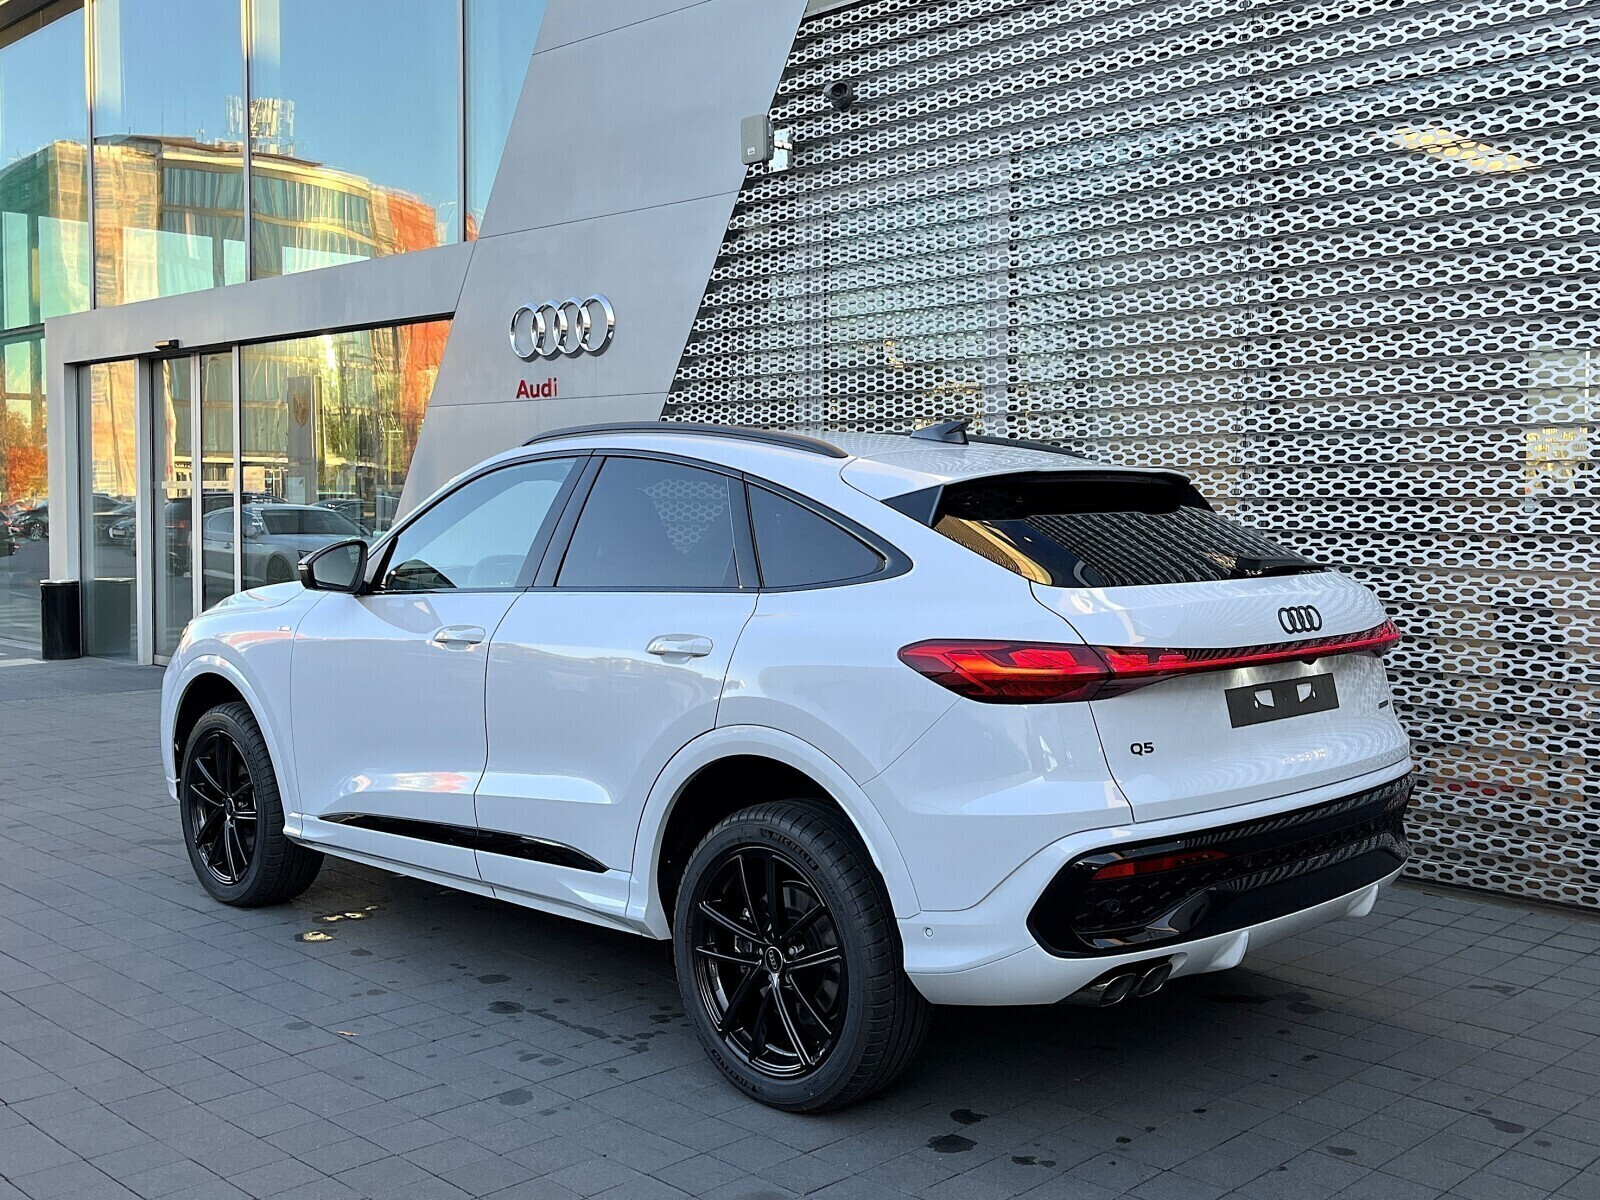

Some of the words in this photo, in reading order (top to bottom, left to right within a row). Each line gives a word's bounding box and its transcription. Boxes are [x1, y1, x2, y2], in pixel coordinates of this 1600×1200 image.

[515, 377, 558, 399] Audi
[1130, 741, 1155, 756] Q5
[768, 832, 818, 870] MICHELIN
